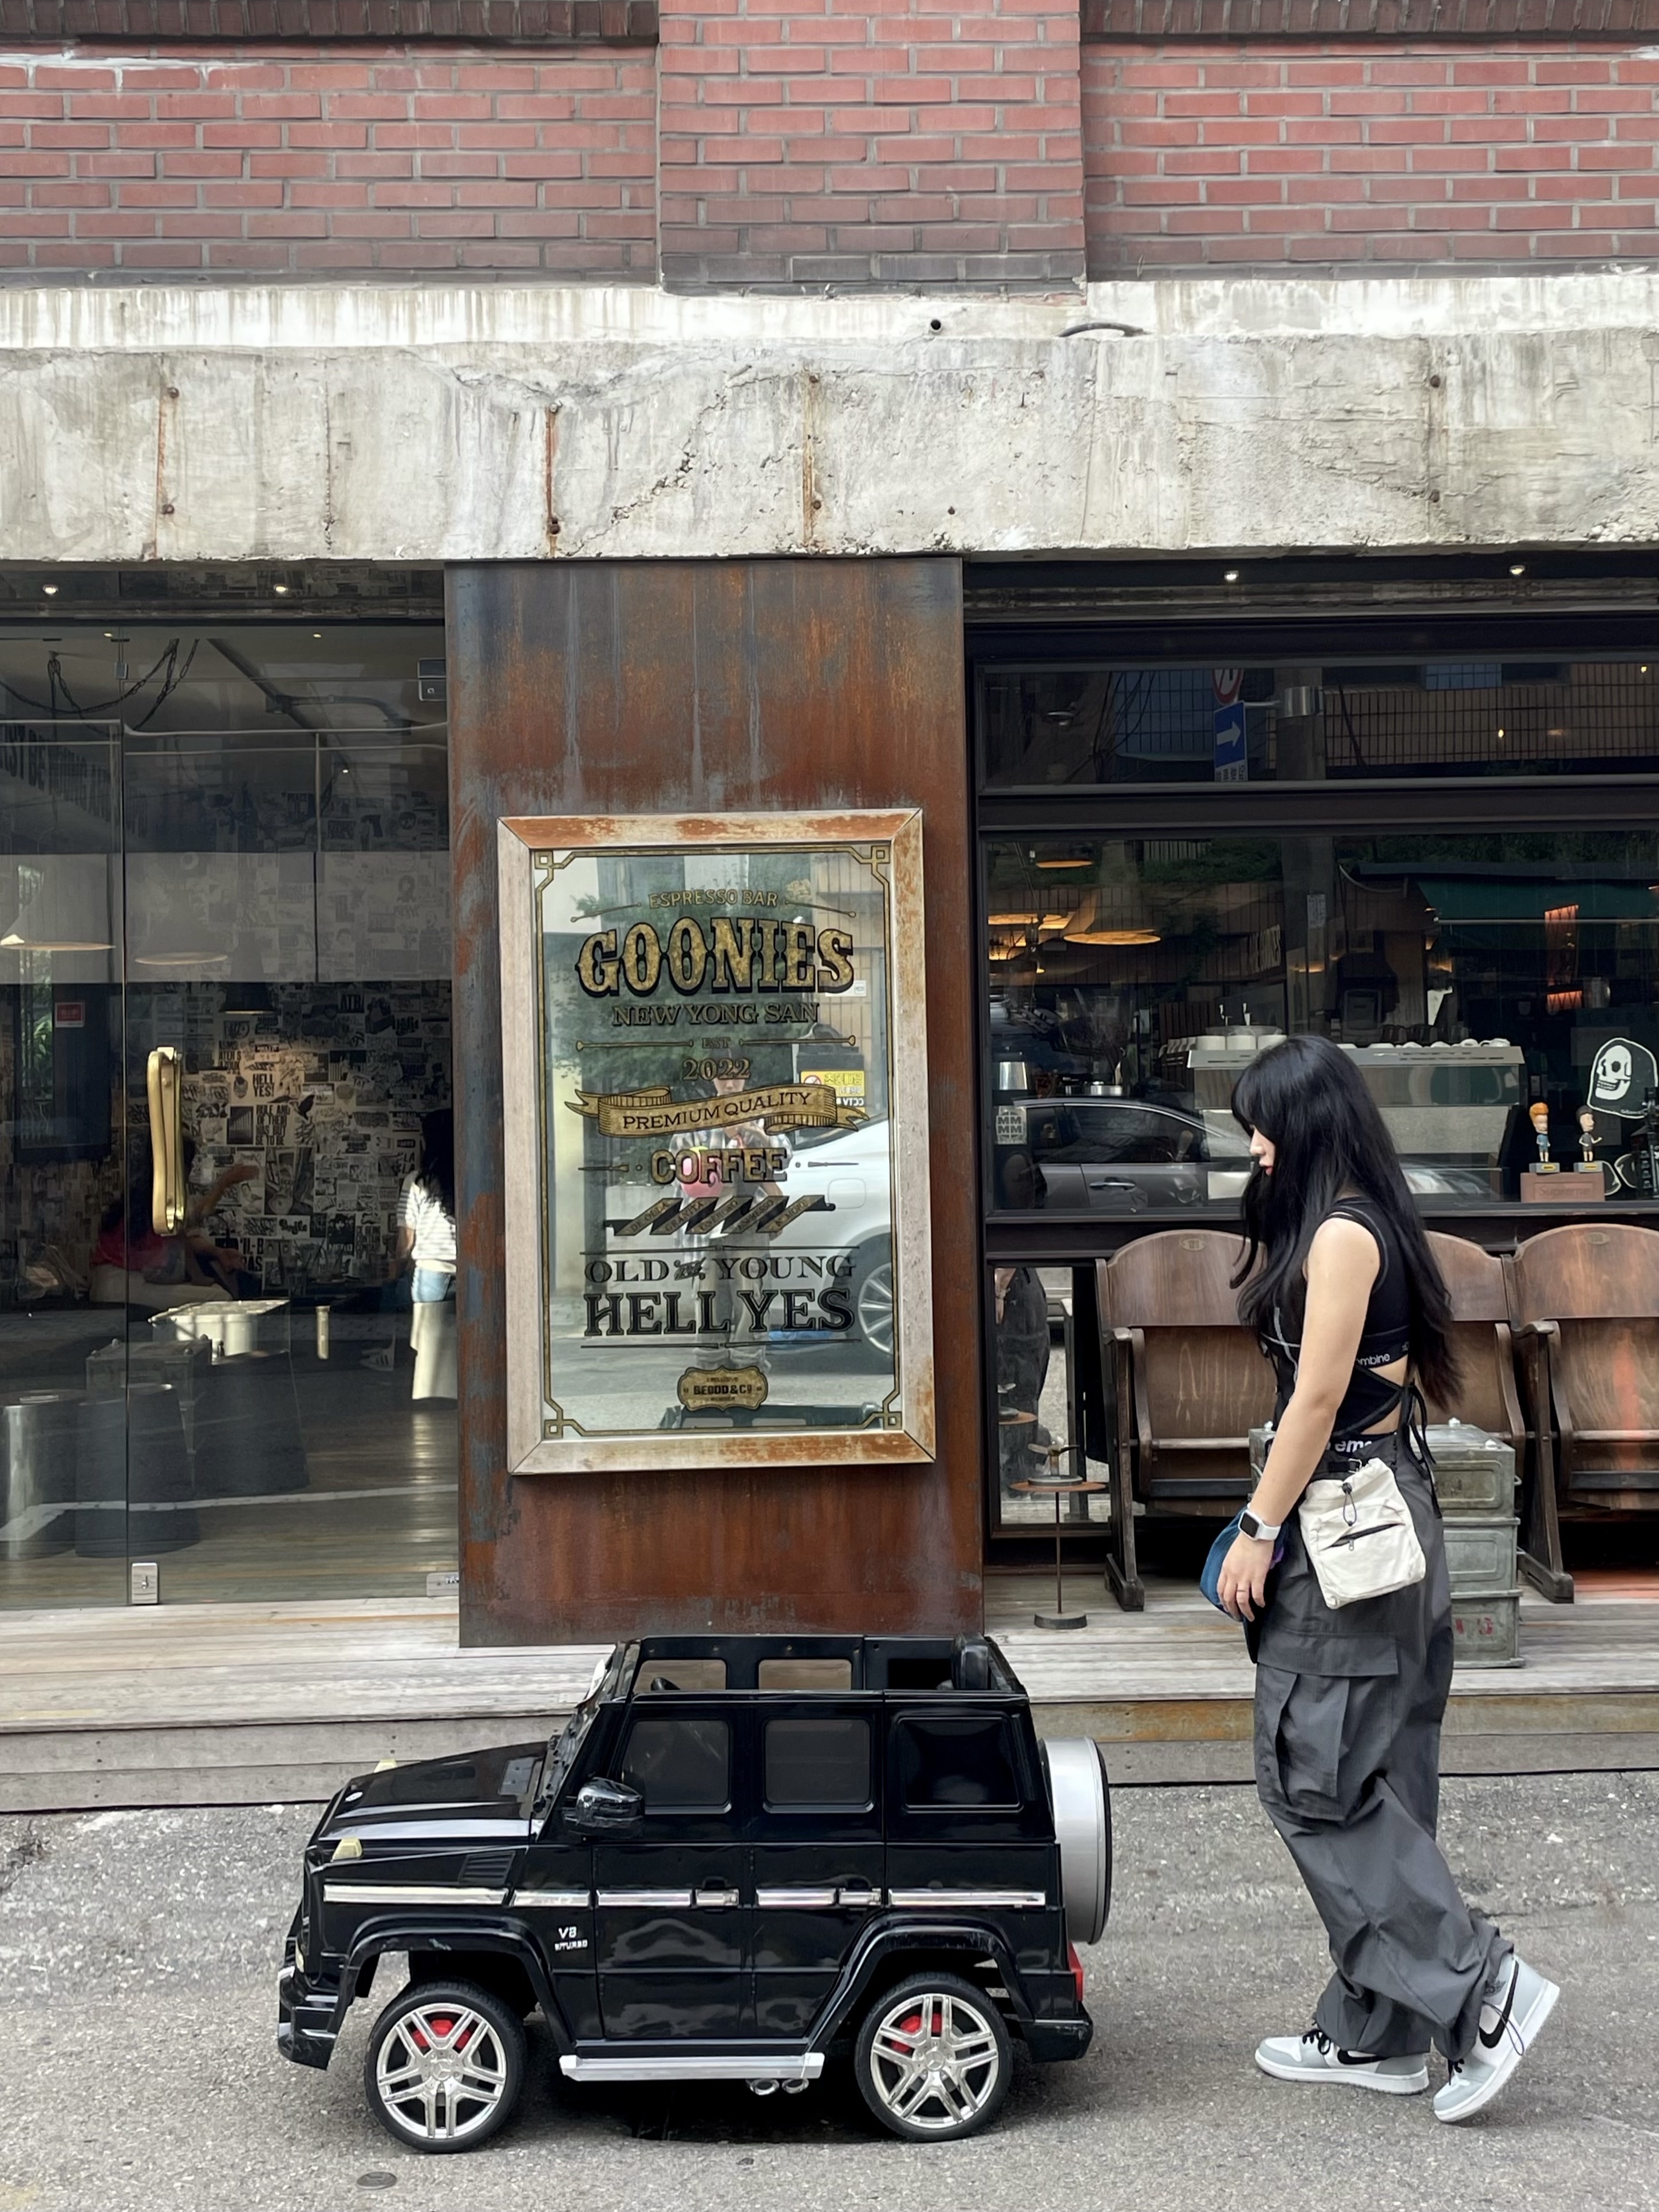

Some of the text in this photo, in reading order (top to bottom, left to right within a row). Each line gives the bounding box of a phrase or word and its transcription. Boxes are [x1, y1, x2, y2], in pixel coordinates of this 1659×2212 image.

[649, 889, 778, 909] ESPRESSO BAR
[575, 917, 854, 997] GOONIES
[612, 1002, 820, 1027] NEW YONG SAN
[701, 1037, 731, 1049] EST
[252, 1073, 274, 1085] HELL
[683, 1058, 750, 1081] 2022
[254, 1084, 275, 1097] YES!
[623, 1091, 812, 1130] PREMIUM QUALITY
[650, 1147, 788, 1185] COFFEE
[1538, 1185, 1591, 1197] Supreme
[584, 1258, 669, 1283] OLD
[713, 1255, 855, 1281] YOUNG
[583, 1288, 855, 1337] HELL YES
[558, 1926, 577, 1939] V8
